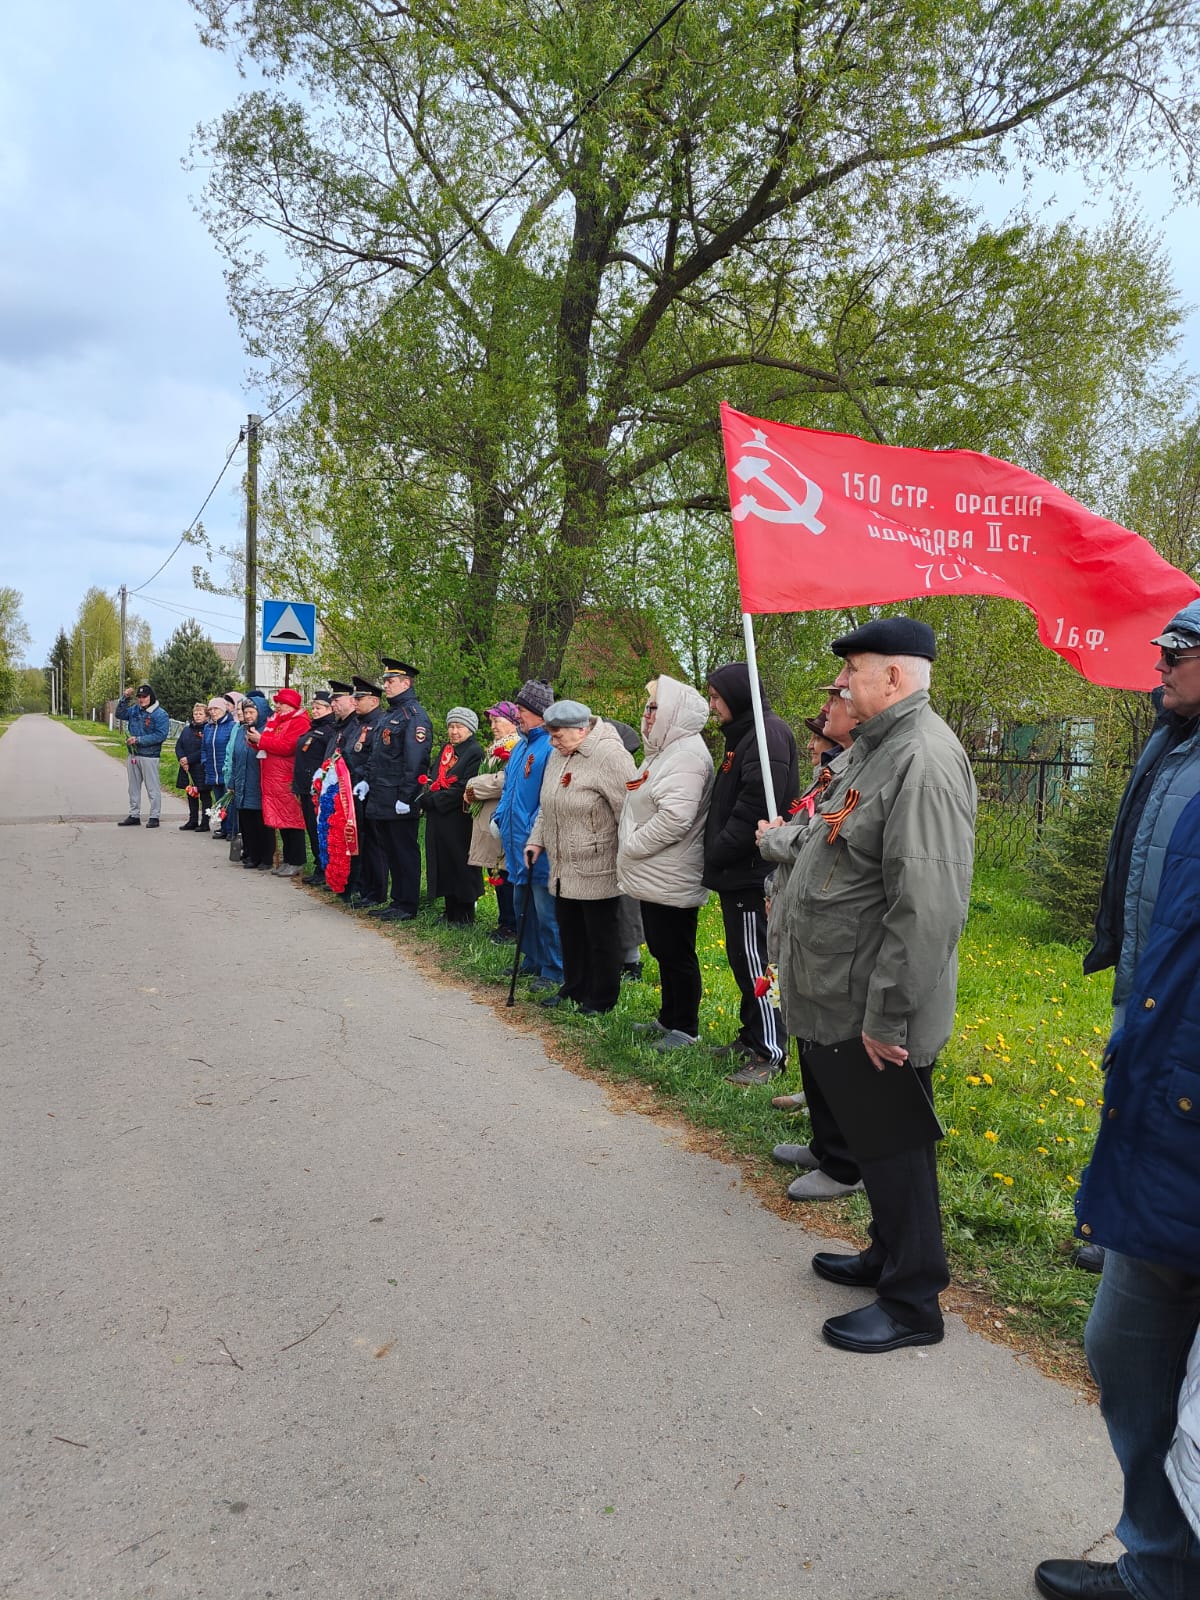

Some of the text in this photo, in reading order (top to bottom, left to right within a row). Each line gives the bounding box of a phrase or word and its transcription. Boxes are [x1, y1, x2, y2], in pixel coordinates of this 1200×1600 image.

[842, 472, 1043, 517] 150 СТР. ОРДЕНА
[1007, 533, 1037, 555] СТ.
